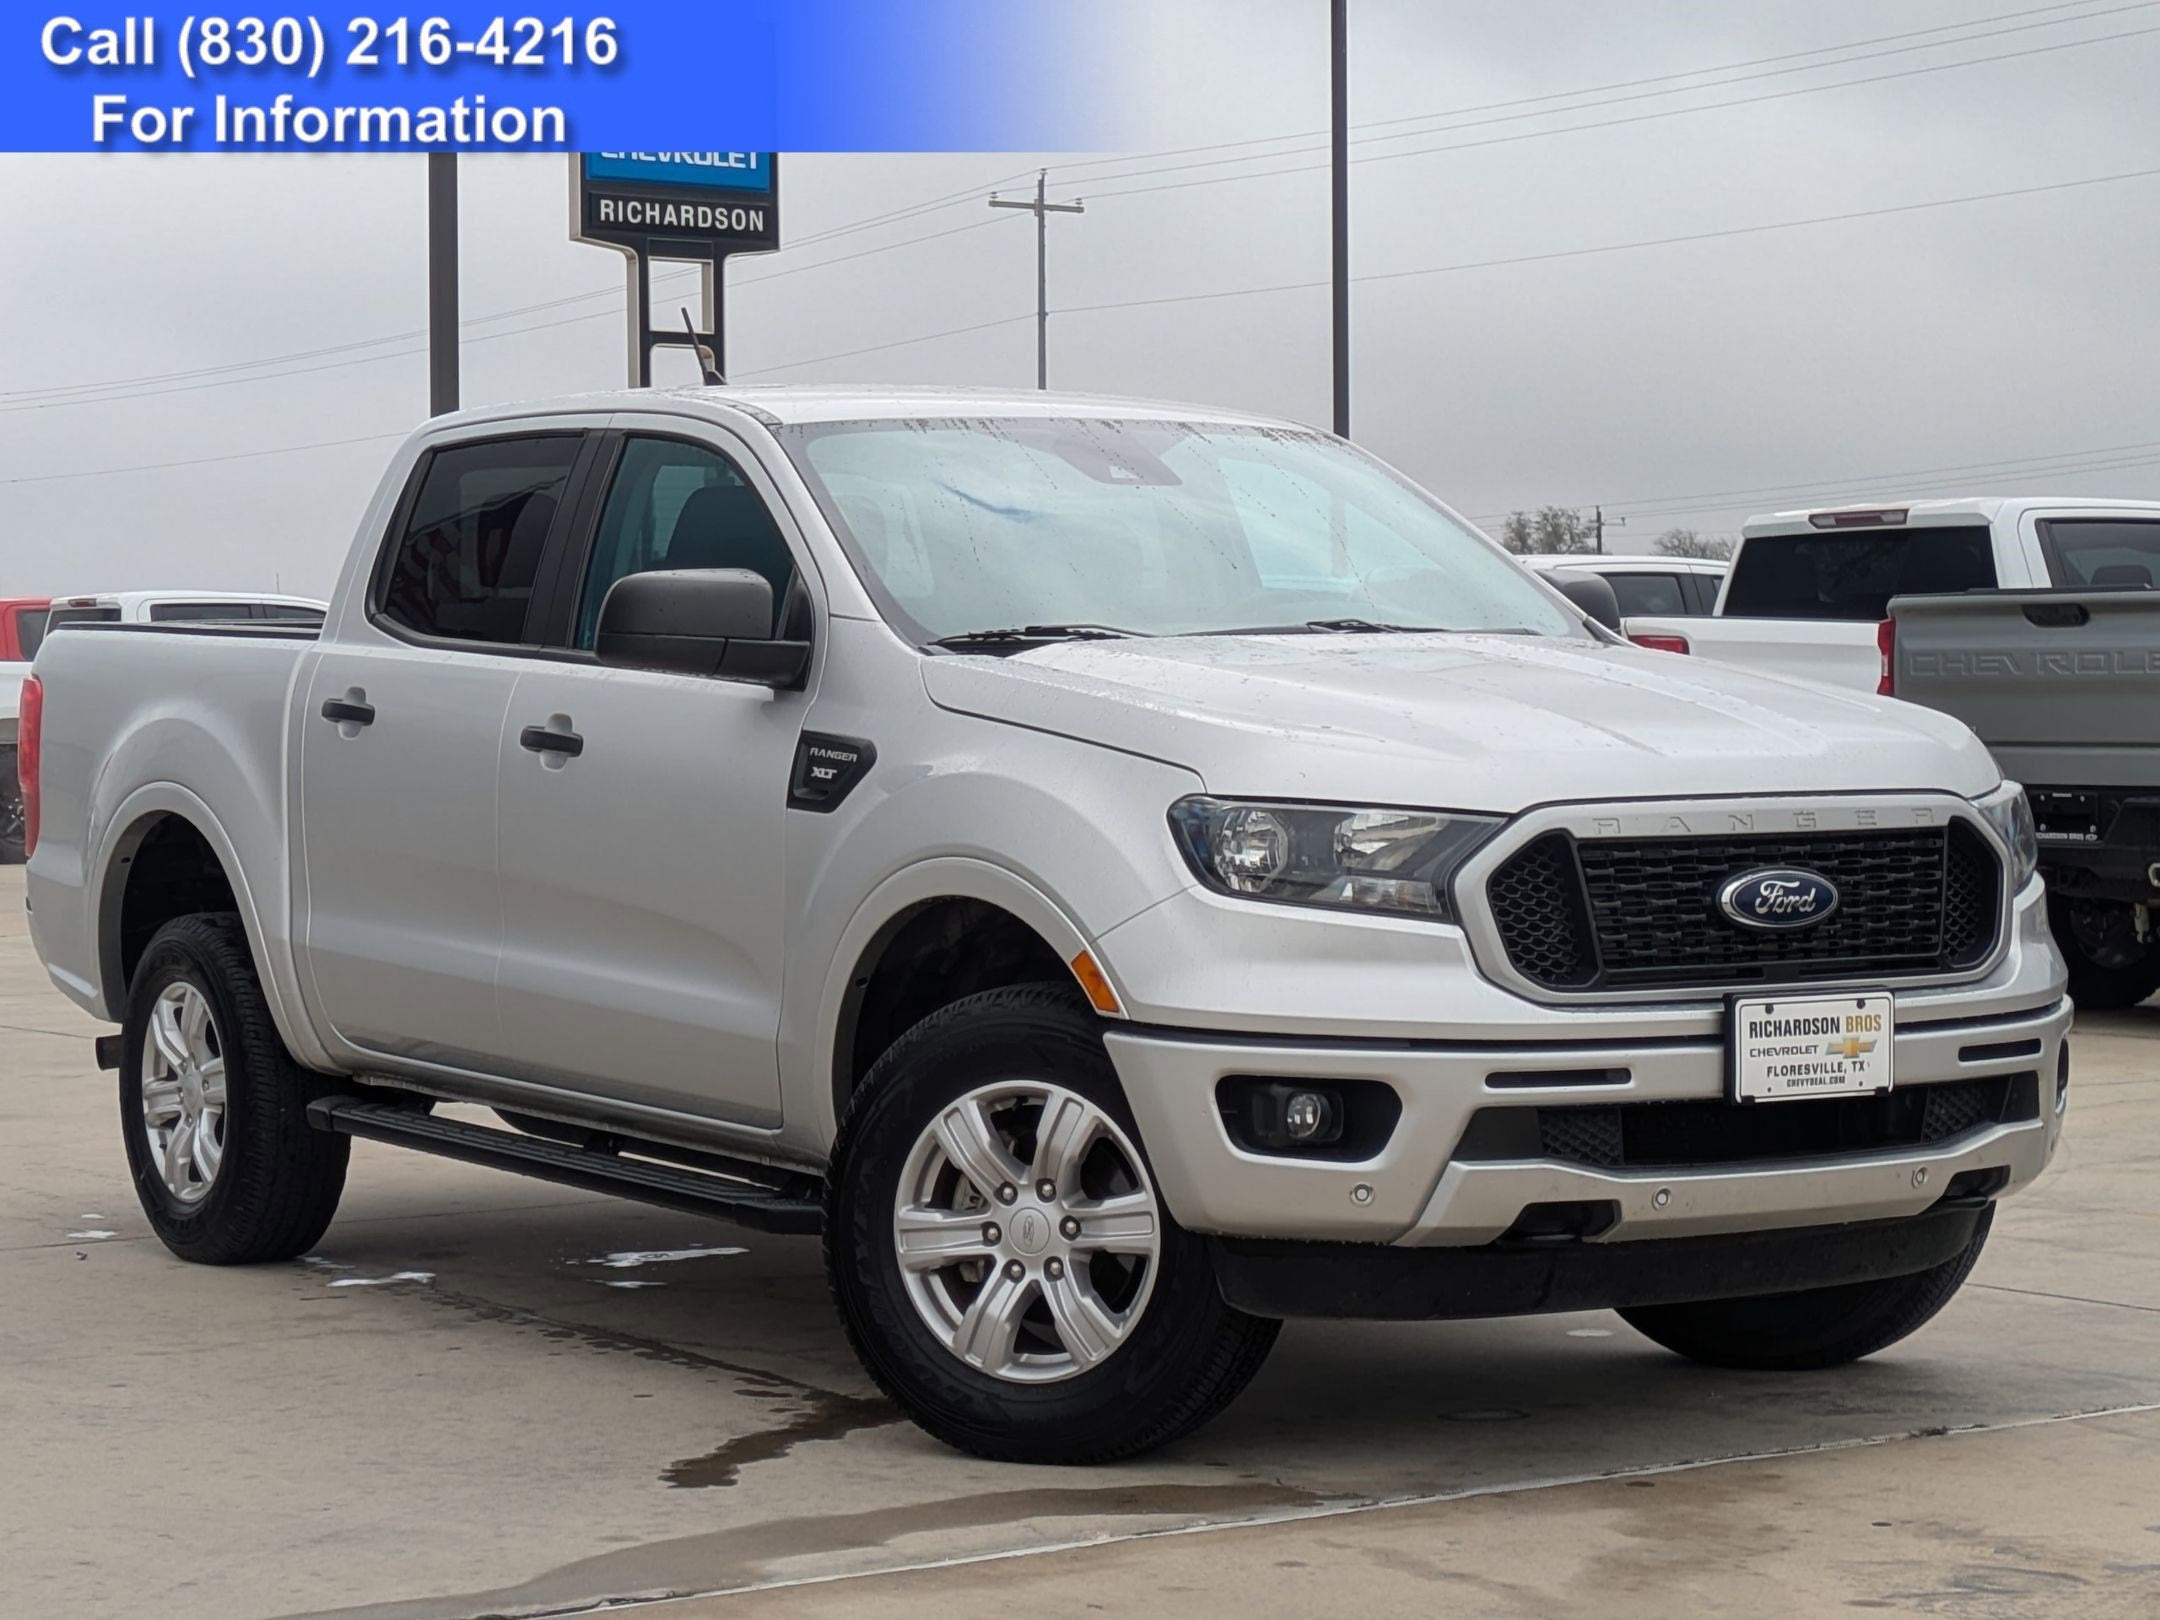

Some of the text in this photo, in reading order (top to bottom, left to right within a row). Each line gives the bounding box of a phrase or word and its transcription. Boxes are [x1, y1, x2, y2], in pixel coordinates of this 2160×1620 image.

[600, 151, 757, 169] ROLET
[600, 199, 764, 232] RICHARDSON
[809, 747, 858, 763] RANGER
[811, 766, 838, 780] XLT
[1591, 807, 1935, 836] RANGER
[1754, 880, 1816, 915] Ford
[1749, 1014, 1882, 1039] RICHARDSON BROS
[1749, 1044, 1819, 1058] CHEVROLET
[1766, 1060, 1865, 1079] FLORESVILLE, TX
